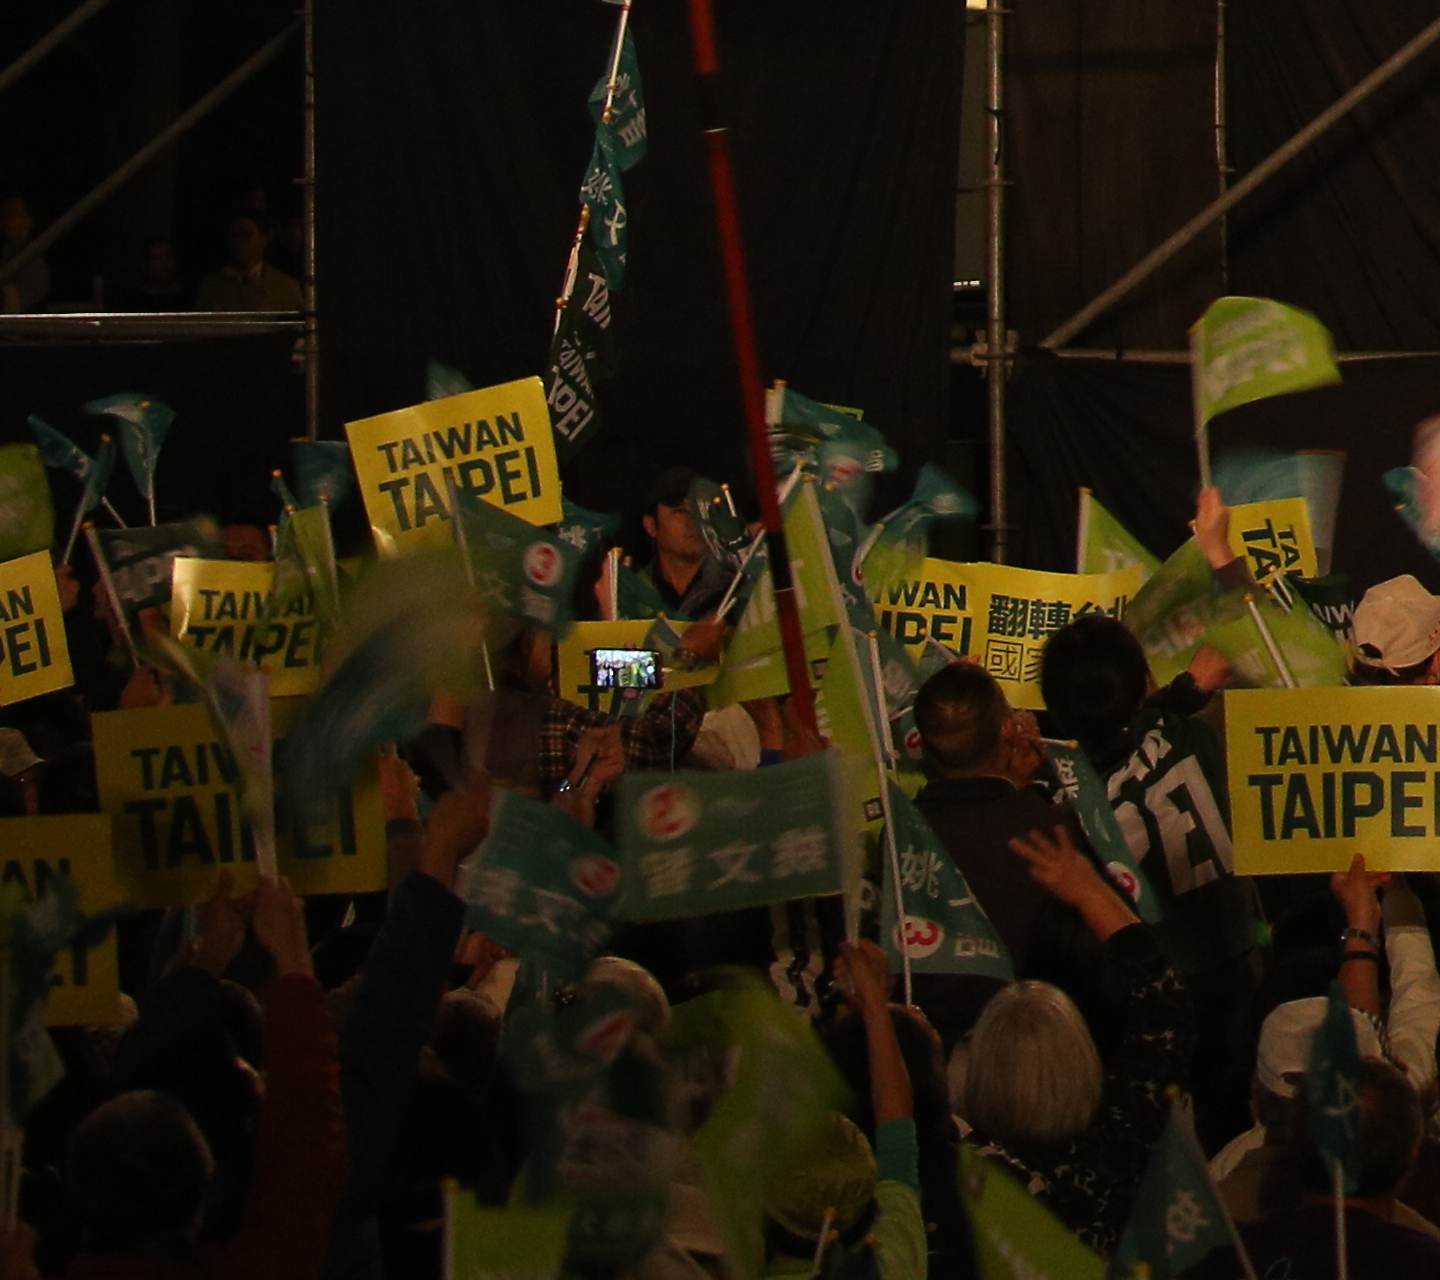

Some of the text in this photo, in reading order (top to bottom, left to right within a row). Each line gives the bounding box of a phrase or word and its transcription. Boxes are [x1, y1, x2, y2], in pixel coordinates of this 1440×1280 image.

[377, 412, 524, 475] TAIWAN
[874, 580, 967, 611] WAN
[1256, 725, 1439, 766] TAIWAN
